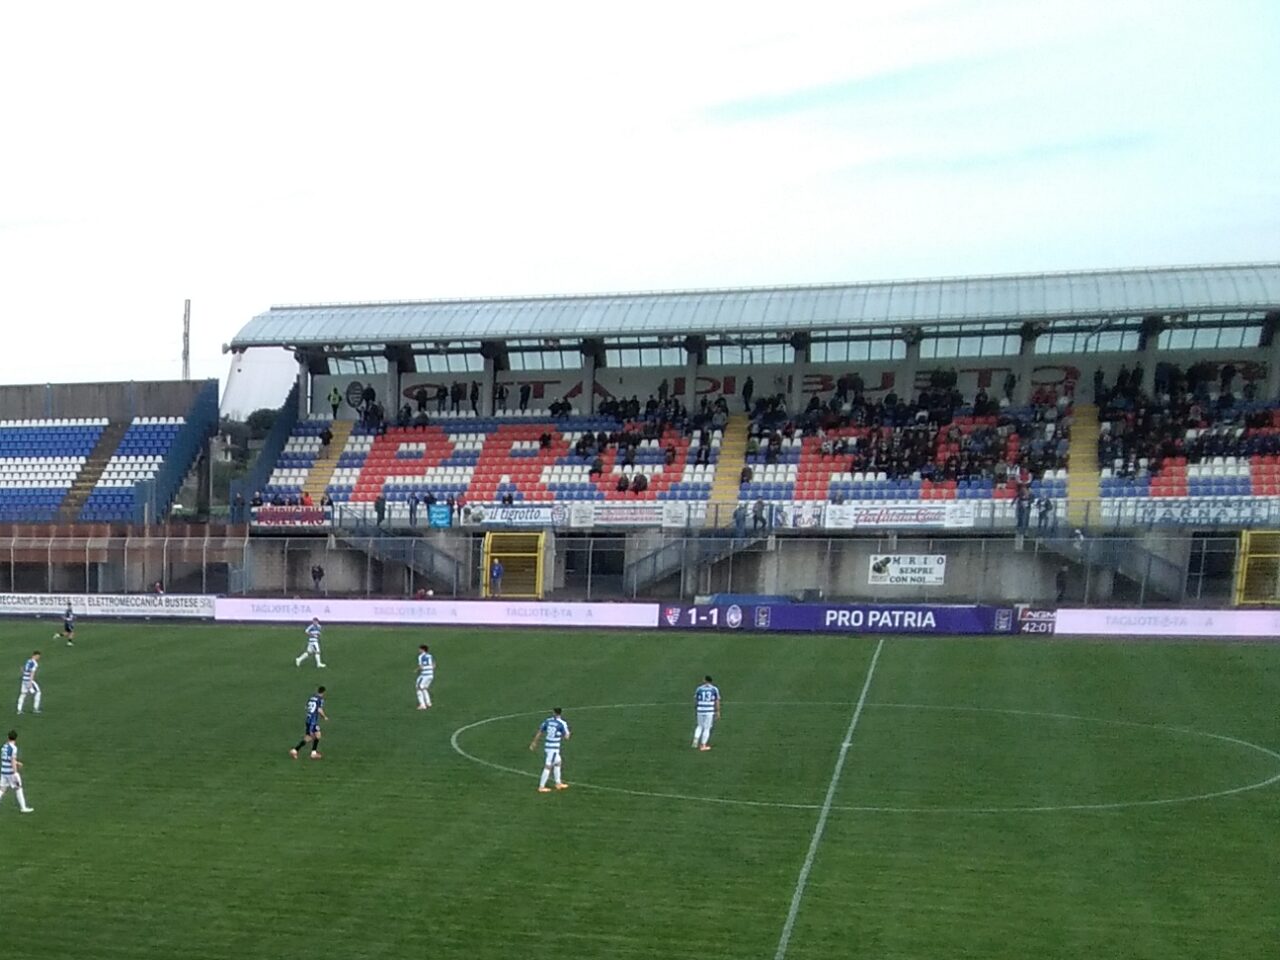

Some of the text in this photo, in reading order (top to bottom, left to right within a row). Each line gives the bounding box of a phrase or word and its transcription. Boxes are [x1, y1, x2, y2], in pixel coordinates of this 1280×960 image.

[40, 597, 71, 606] BUSTESE
[87, 596, 163, 607] ELETTROMECCANICA
[165, 597, 198, 607] BUSTESE
[688, 607, 718, 625] 1-1
[825, 610, 937, 628] PRO PATRIA
[1022, 622, 1053, 633] 42:01
